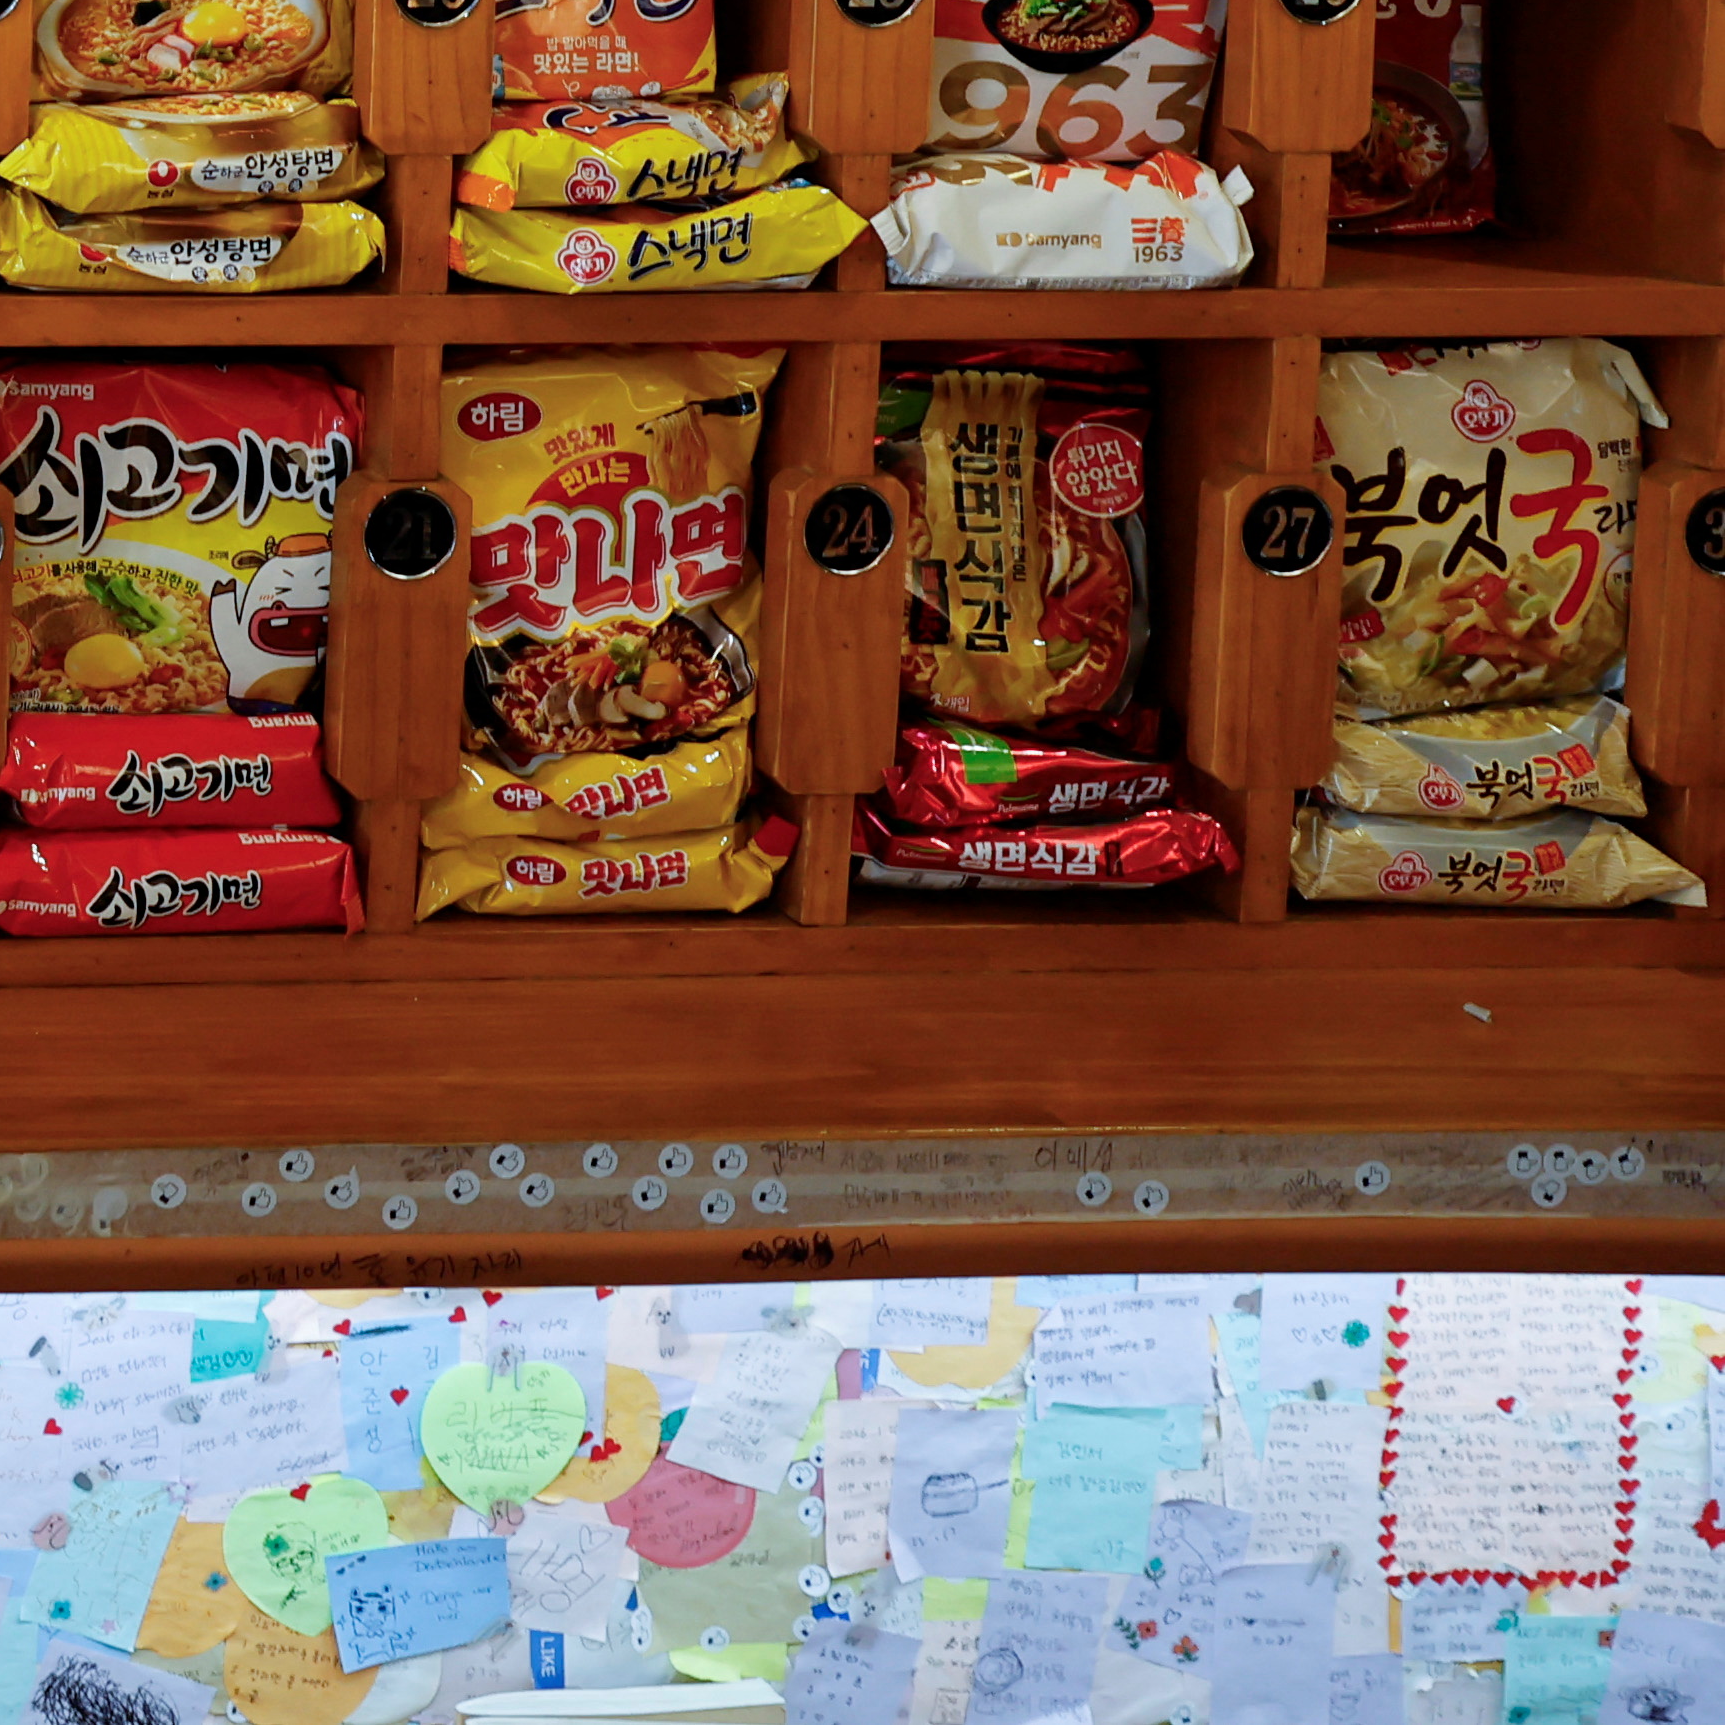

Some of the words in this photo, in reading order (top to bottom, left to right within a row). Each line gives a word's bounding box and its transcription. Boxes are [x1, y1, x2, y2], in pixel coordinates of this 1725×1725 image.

[533, 54, 589, 75] 맛있는
[594, 52, 640, 74] 라면!
[938, 60, 1213, 160] 963
[627, 211, 753, 282] 스낵면
[1133, 245, 1185, 264] 1963
[8, 379, 95, 401] Samyang
[470, 400, 526, 434] 하림
[1464, 408, 1508, 431] 오뚜기
[543, 423, 617, 462] 맛있게
[1066, 439, 1124, 470] 튀기지
[558, 456, 631, 497] 만나는
[822, 502, 880, 560] 24
[947, 421, 1012, 654] 생면식감
[1262, 505, 1317, 559] 27
[101, 559, 151, 579] 구수하고
[185, 581, 199, 596] 맛
[470, 486, 746, 636] 맛나면
[106, 751, 271, 817] 쇠고기면
[516, 859, 556, 881] 하림
[579, 850, 688, 900] 맛나면
[959, 841, 1101, 876] 생면식감
[86, 866, 263, 929] 쇠고기면
